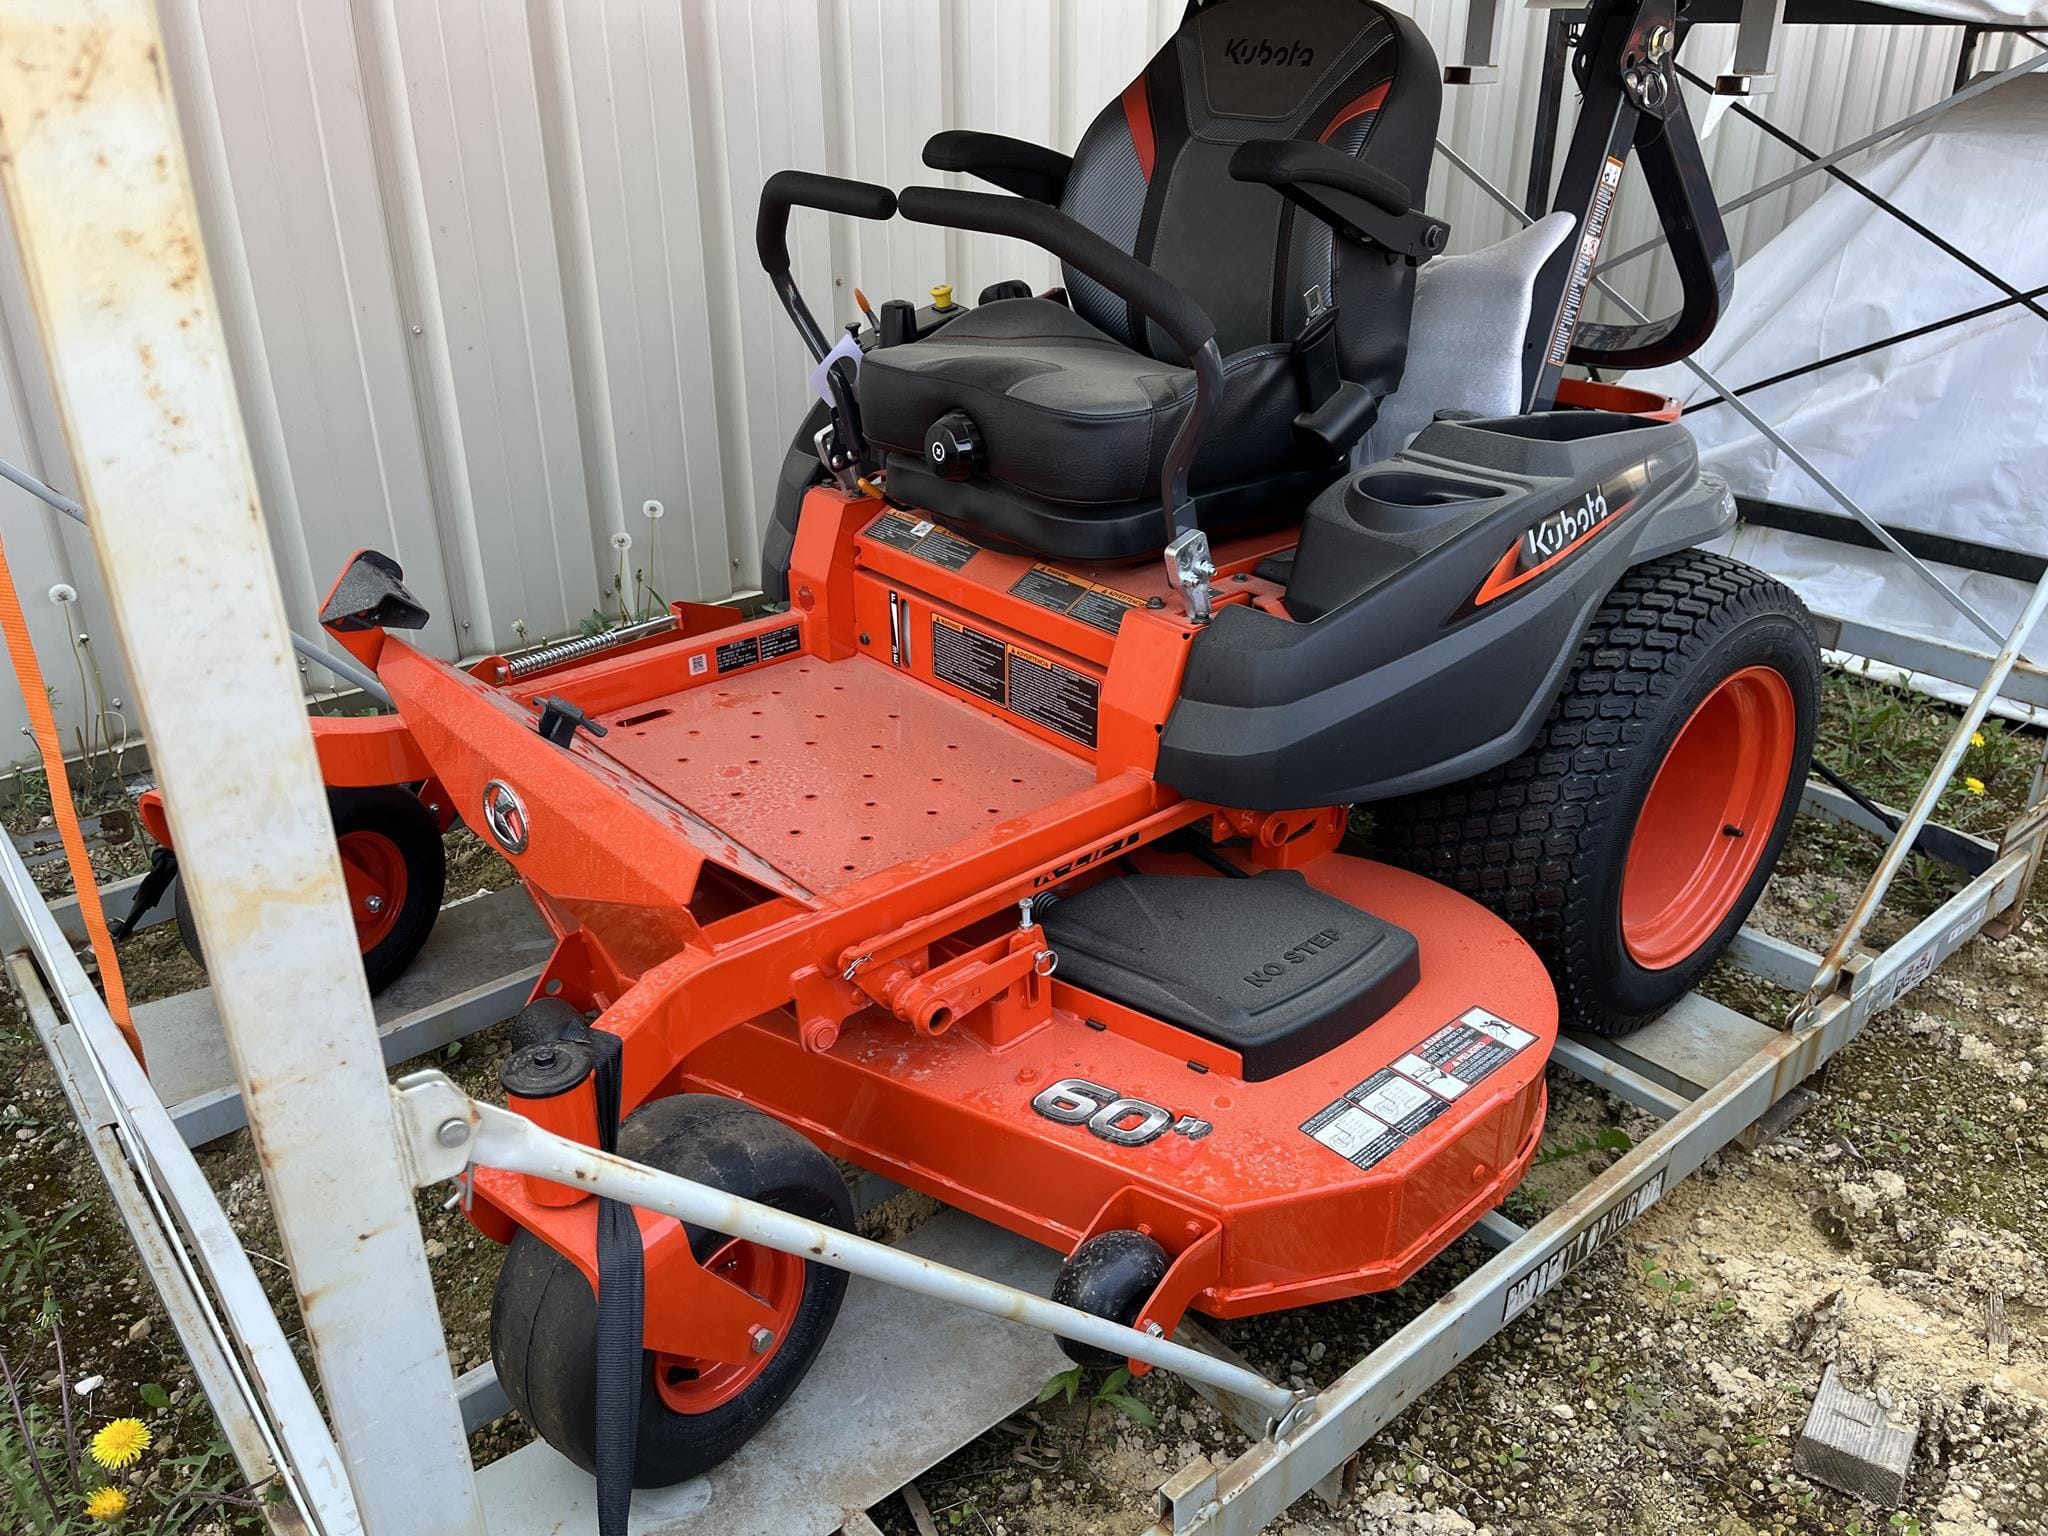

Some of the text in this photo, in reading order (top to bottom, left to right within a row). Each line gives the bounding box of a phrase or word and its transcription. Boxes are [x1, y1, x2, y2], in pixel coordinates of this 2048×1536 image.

[1224, 37, 1314, 67] Kubota
[1527, 493, 1608, 556] Kubota
[890, 592, 897, 602] F
[893, 653, 899, 664] E
[1016, 650, 1049, 668] ADVERTENCIA
[1243, 927, 1341, 988] NO STEP
[1426, 1025, 1455, 1046] DANGER
[1457, 1041, 1486, 1063] PELIGRO
